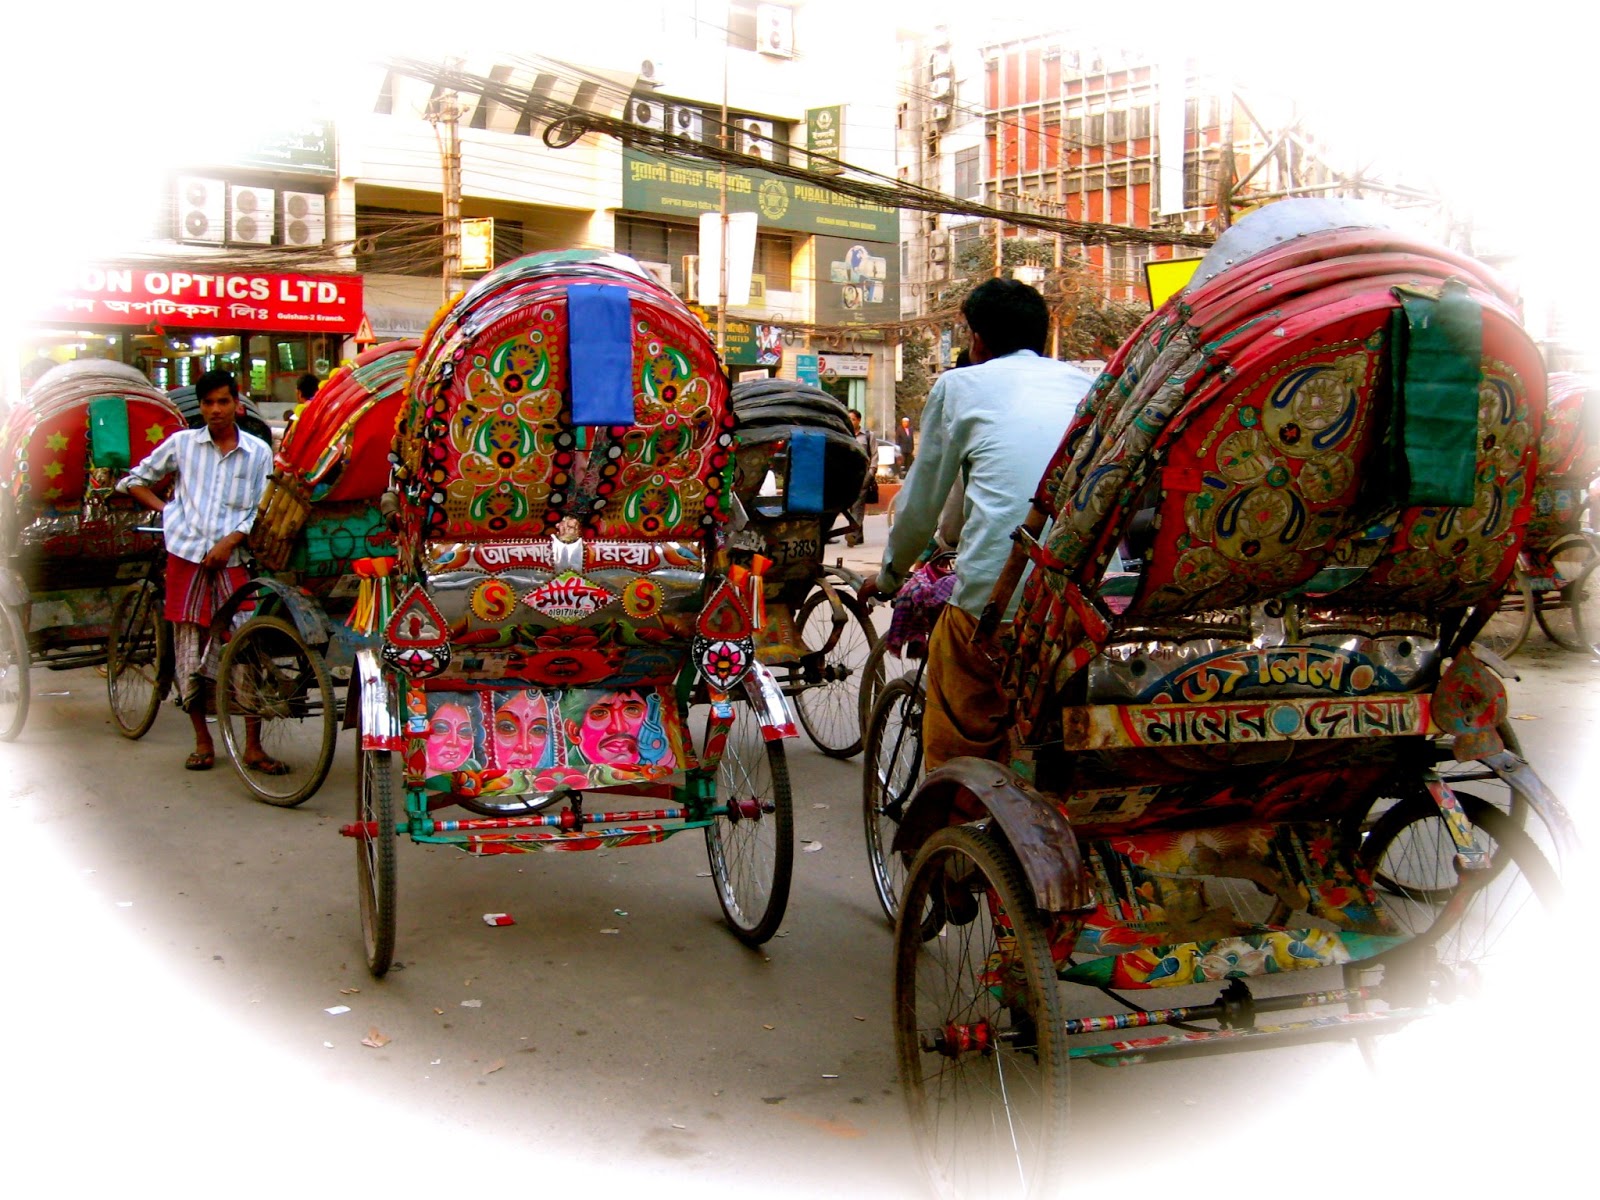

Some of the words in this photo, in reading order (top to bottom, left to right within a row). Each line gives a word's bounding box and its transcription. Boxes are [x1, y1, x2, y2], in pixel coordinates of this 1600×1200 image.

[794, 184, 829, 204] PUBALI
[144, 272, 270, 301] OPTICS
[280, 279, 346, 304] LTD.
[227, 302, 269, 320] লিঃ
[484, 585, 506, 616] S
[635, 582, 655, 612] S
[1140, 703, 1271, 742] মায়ের
[1303, 699, 1410, 738] দোয়া
